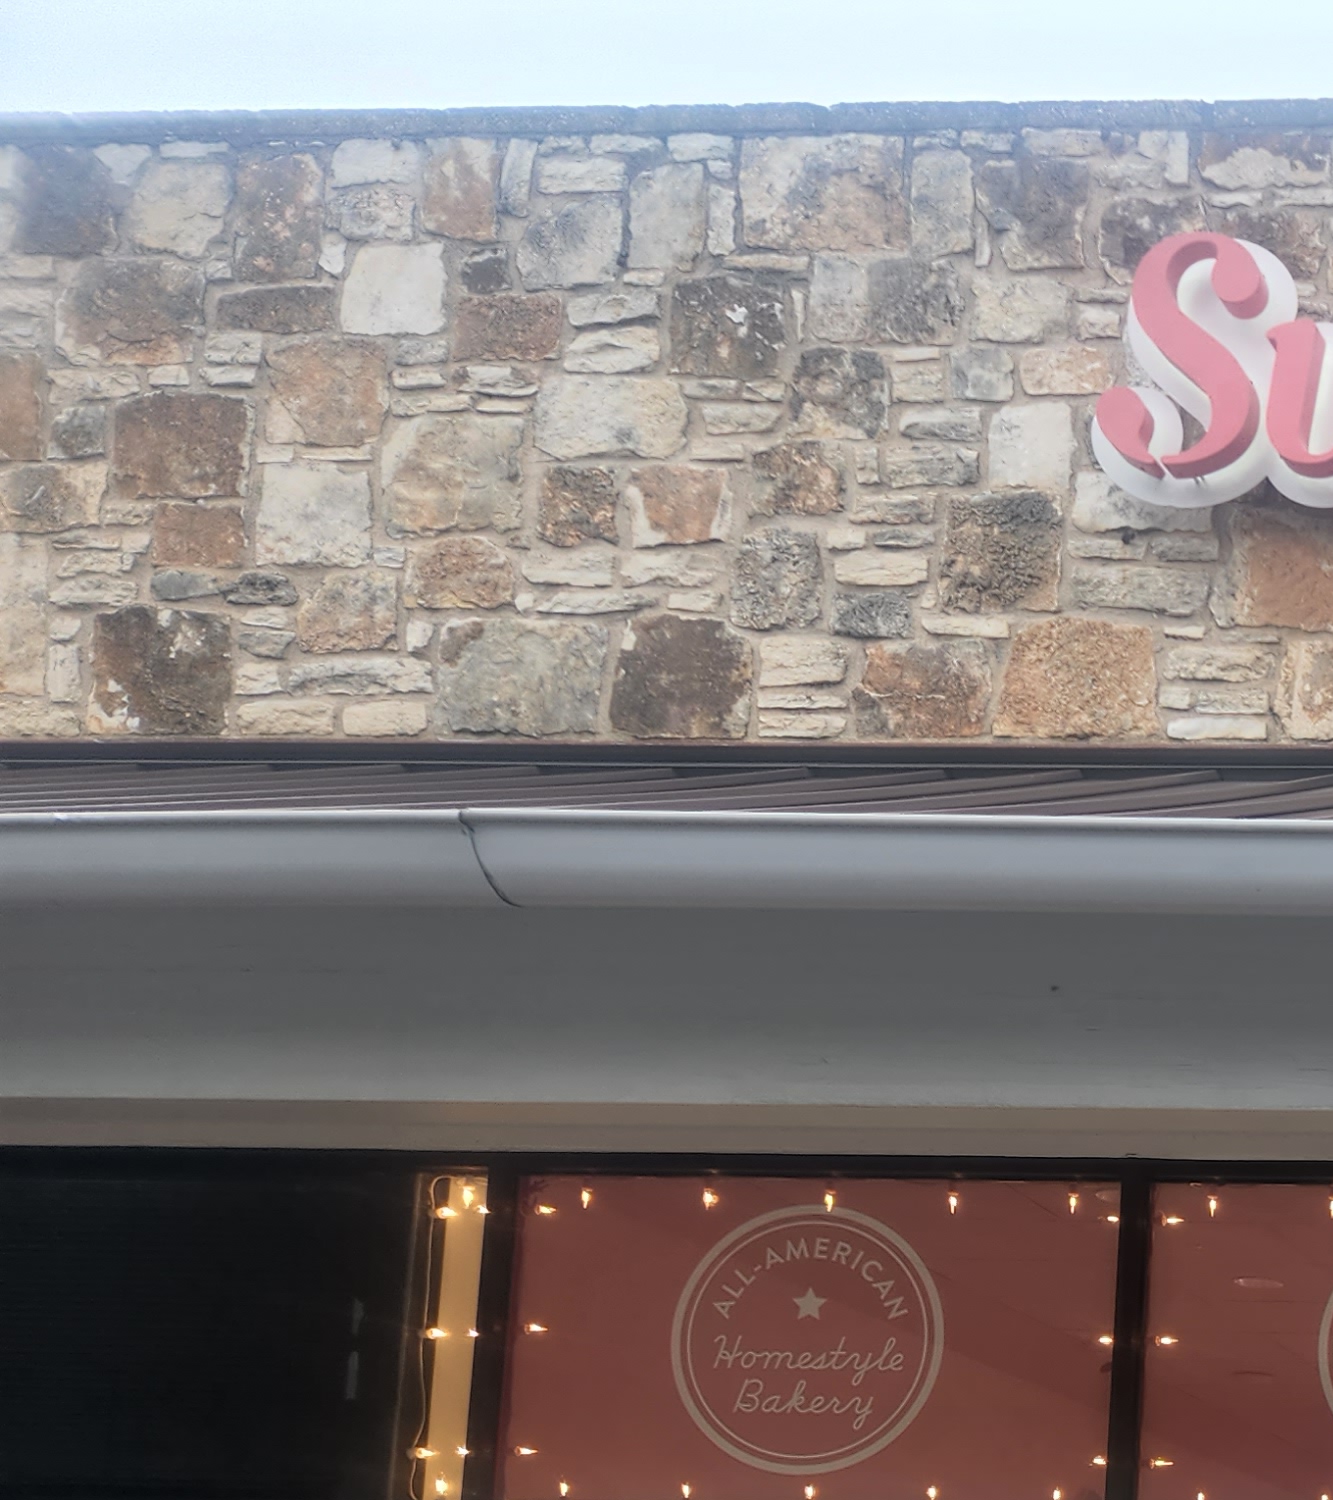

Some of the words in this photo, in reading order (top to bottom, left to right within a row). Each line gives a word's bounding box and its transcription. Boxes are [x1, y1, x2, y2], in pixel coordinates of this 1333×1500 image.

[712, 1237, 909, 1320] ALL-AMERICAN
[712, 1334, 906, 1386] Homestyle
[733, 1378, 873, 1430] Bakery
